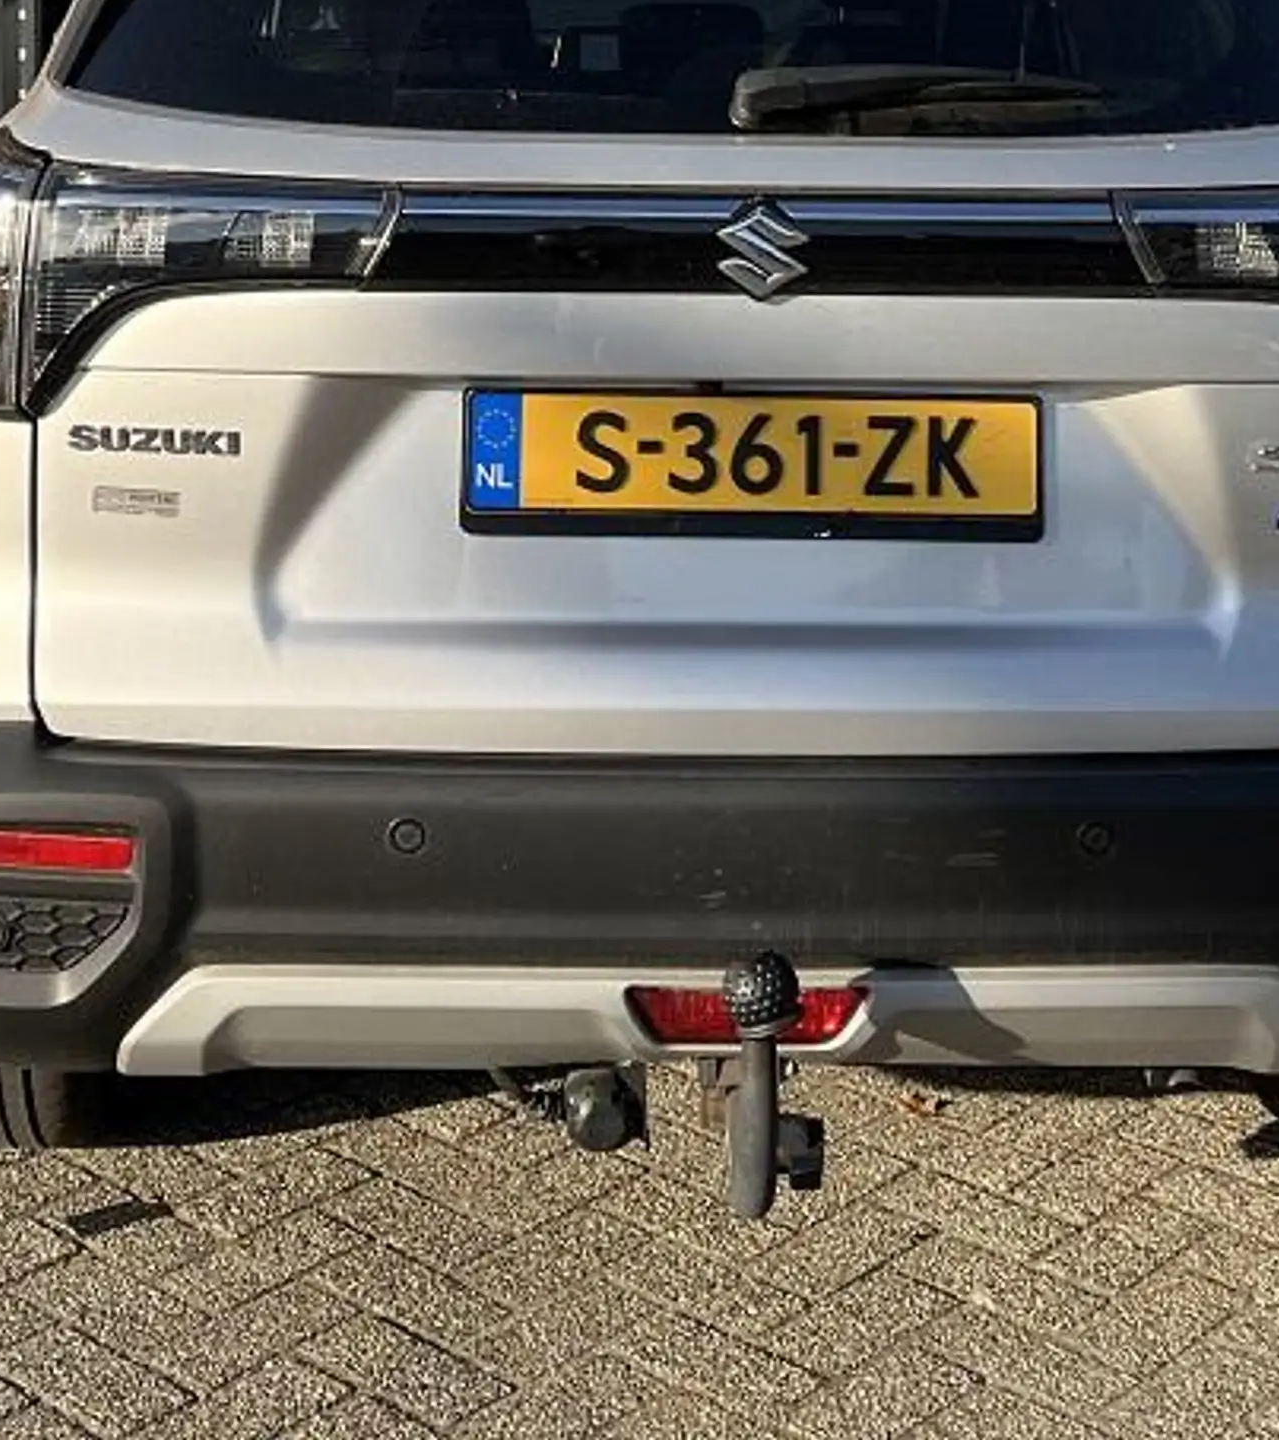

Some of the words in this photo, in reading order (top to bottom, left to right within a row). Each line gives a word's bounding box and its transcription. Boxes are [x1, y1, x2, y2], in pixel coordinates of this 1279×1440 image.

[69, 424, 241, 456] SUZUKI
[575, 410, 980, 499] S-361-ZK
[476, 464, 513, 488] NL
